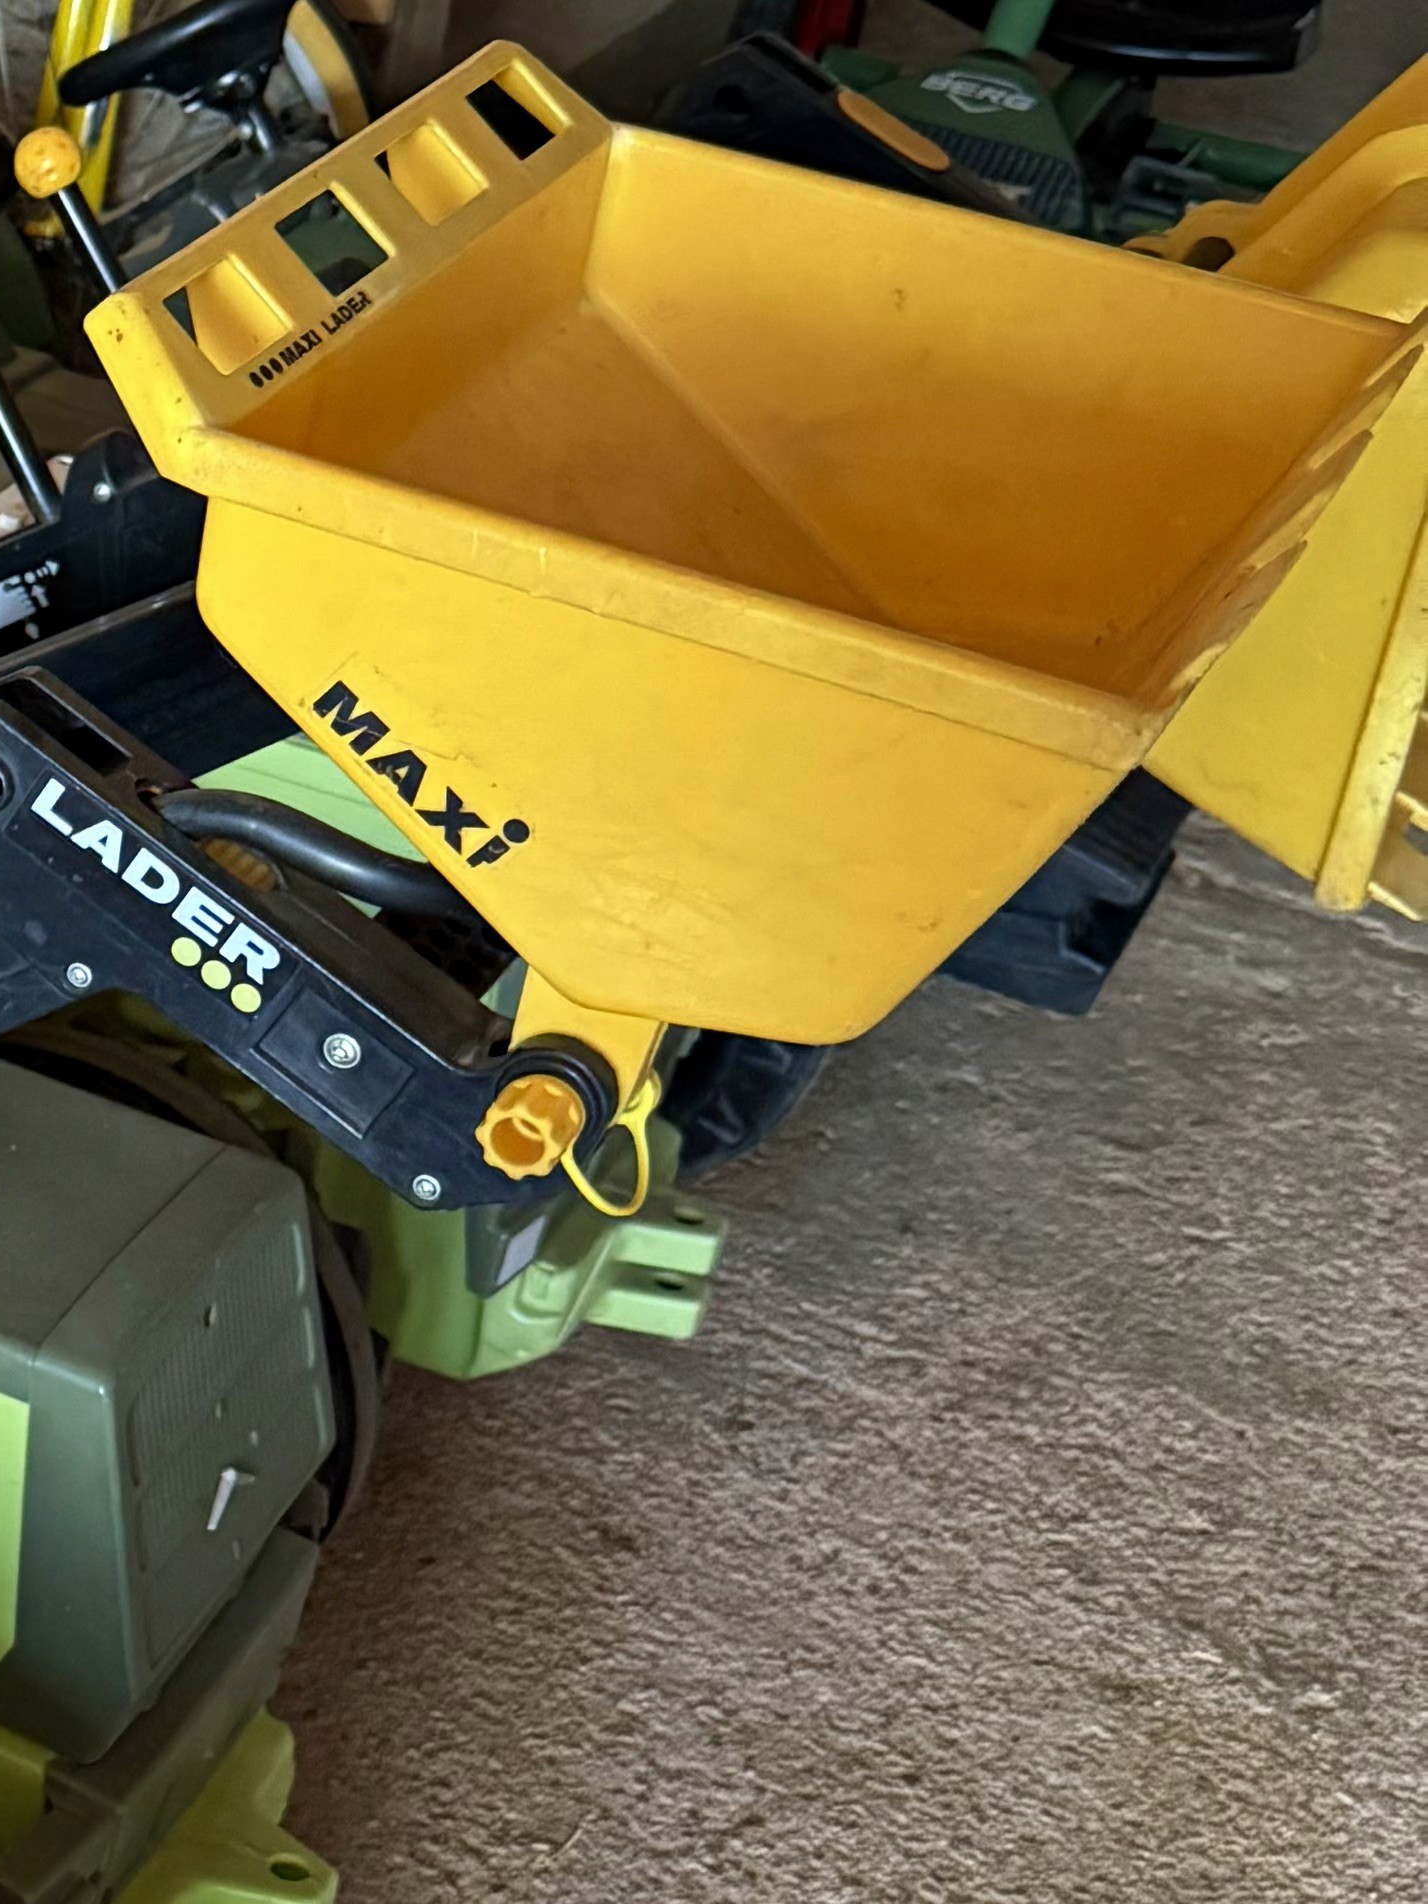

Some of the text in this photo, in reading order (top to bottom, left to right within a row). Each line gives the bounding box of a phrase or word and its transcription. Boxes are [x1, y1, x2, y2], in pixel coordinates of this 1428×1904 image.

[278, 290, 373, 367] MAXI LADER
[30, 777, 282, 986] LADER
